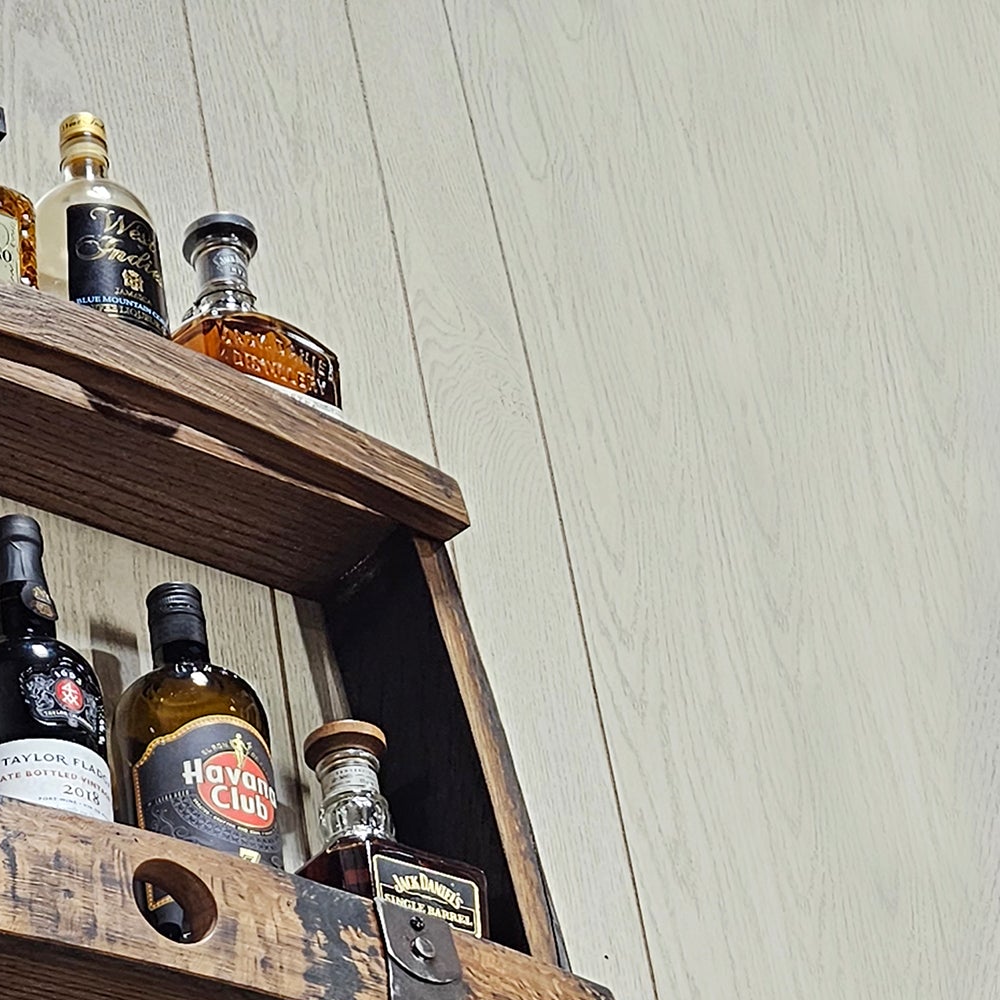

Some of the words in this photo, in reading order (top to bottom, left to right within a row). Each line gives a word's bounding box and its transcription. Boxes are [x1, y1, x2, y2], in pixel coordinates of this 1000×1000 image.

[76, 295, 101, 305] BLUE
[102, 295, 152, 316] MOUNTAIN
[1, 753, 69, 767] TAYLOR
[25, 768, 78, 781] BOTTLED
[181, 758, 278, 810] Havana
[63, 784, 100, 807] 2018
[210, 784, 269, 821] Club
[392, 874, 419, 894] JACK
[384, 893, 425, 914] SINGLE
[427, 906, 474, 927] BARREL
